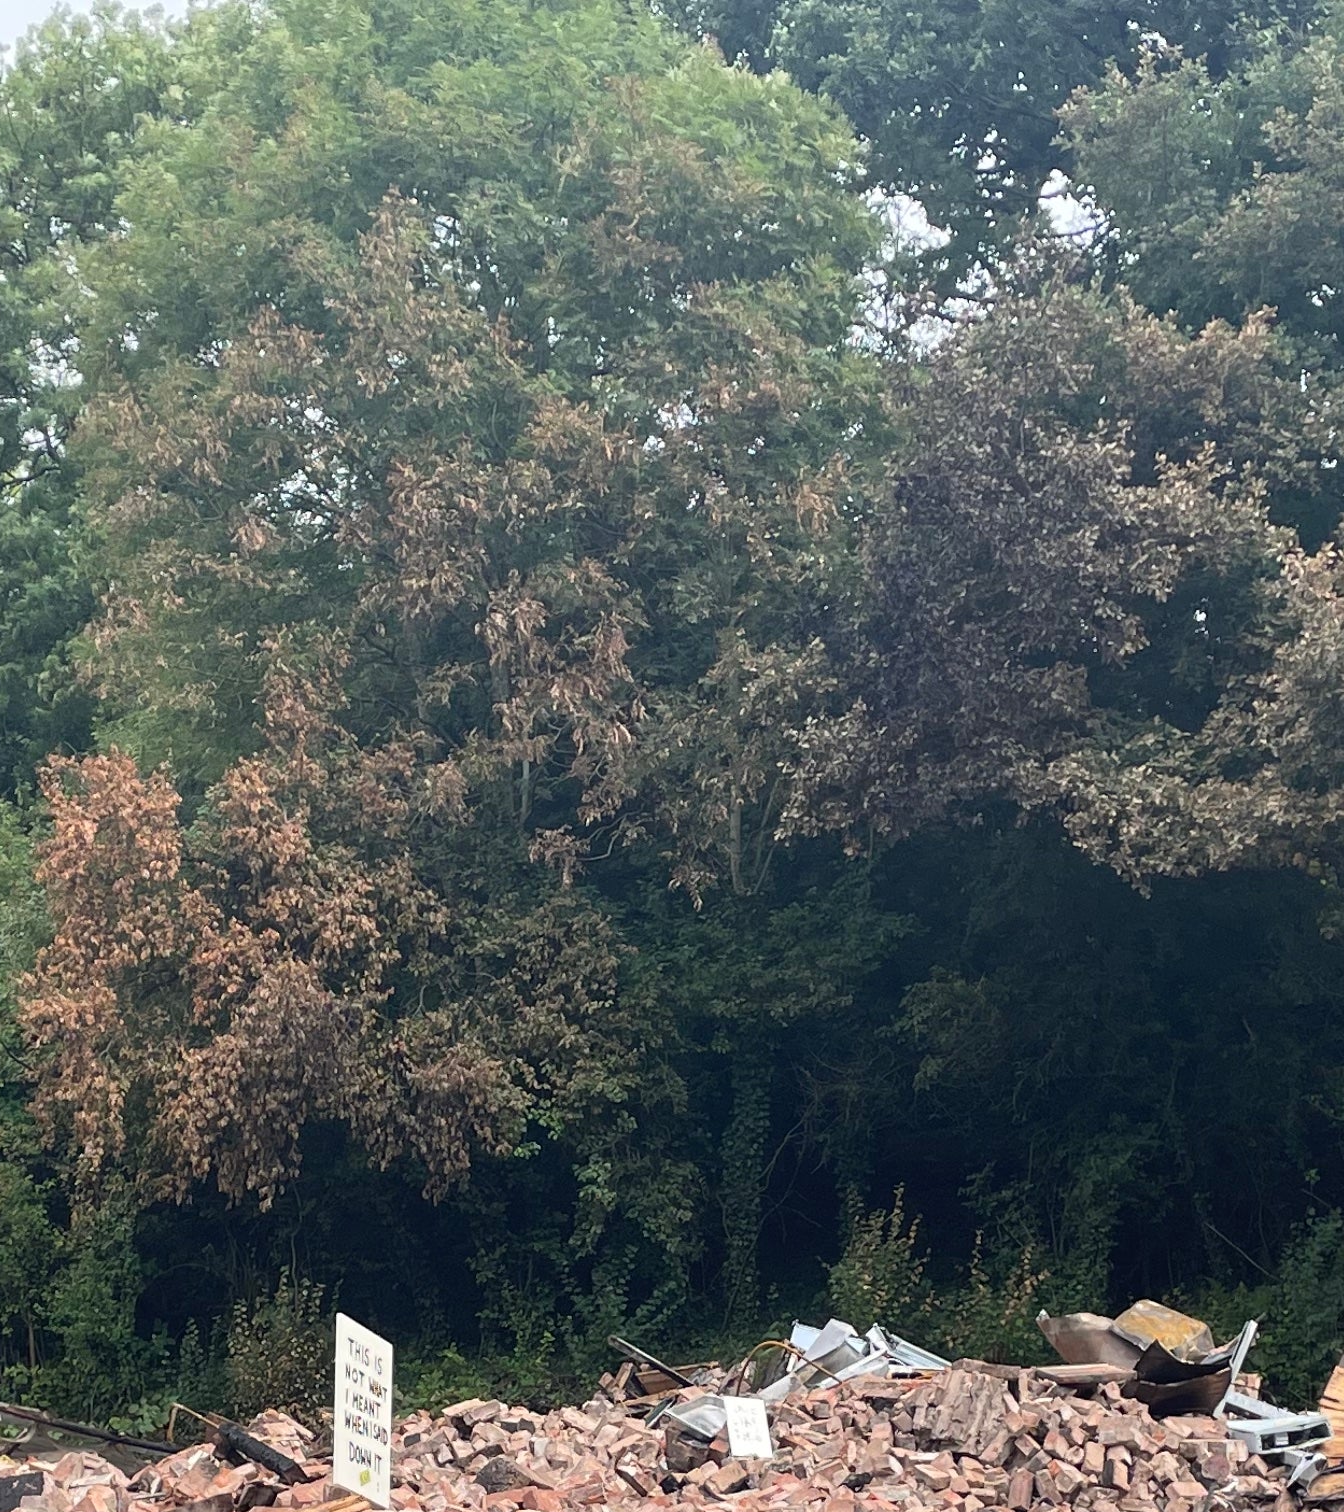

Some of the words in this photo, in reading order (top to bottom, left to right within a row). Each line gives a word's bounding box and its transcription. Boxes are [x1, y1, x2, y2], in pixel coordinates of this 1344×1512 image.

[347, 1337, 370, 1366] THIS
[374, 1355, 383, 1375] IS
[345, 1363, 365, 1387] NOT
[352, 1393, 381, 1419] MEANT
[344, 1410, 368, 1435] WHEN
[374, 1454, 382, 1476] IT
